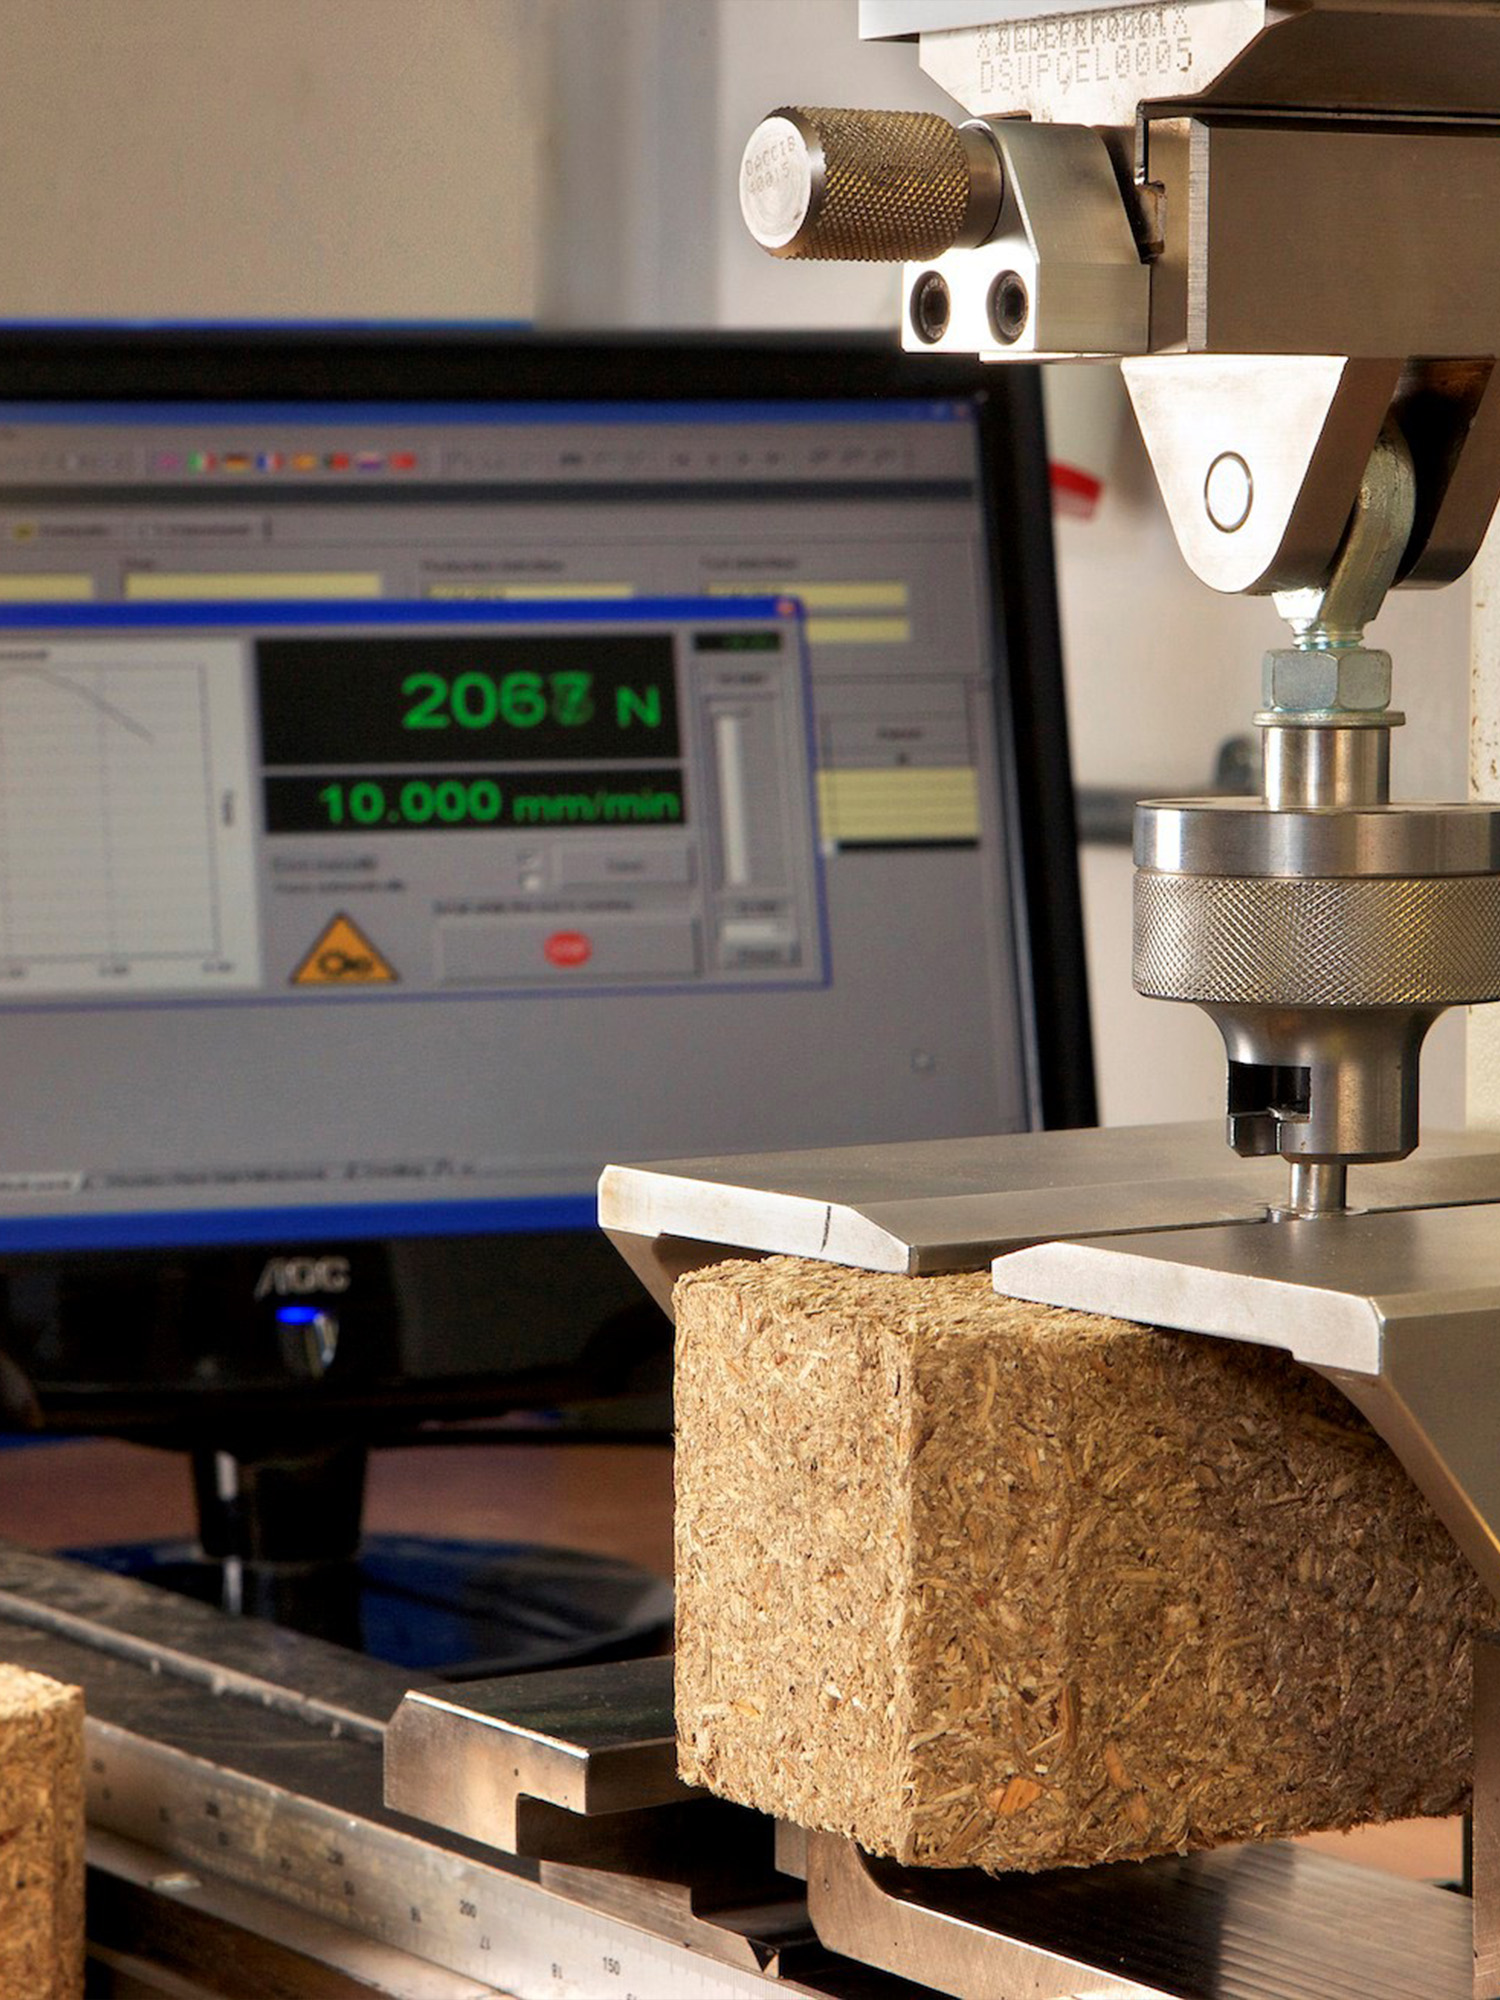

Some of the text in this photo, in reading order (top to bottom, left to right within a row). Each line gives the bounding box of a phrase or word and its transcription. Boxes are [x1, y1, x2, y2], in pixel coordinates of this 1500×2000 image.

[614, 684, 662, 729] N
[320, 780, 681, 823] 10.000 mm/min
[254, 1256, 351, 1301] AOC
[602, 1956, 621, 1976] 150
